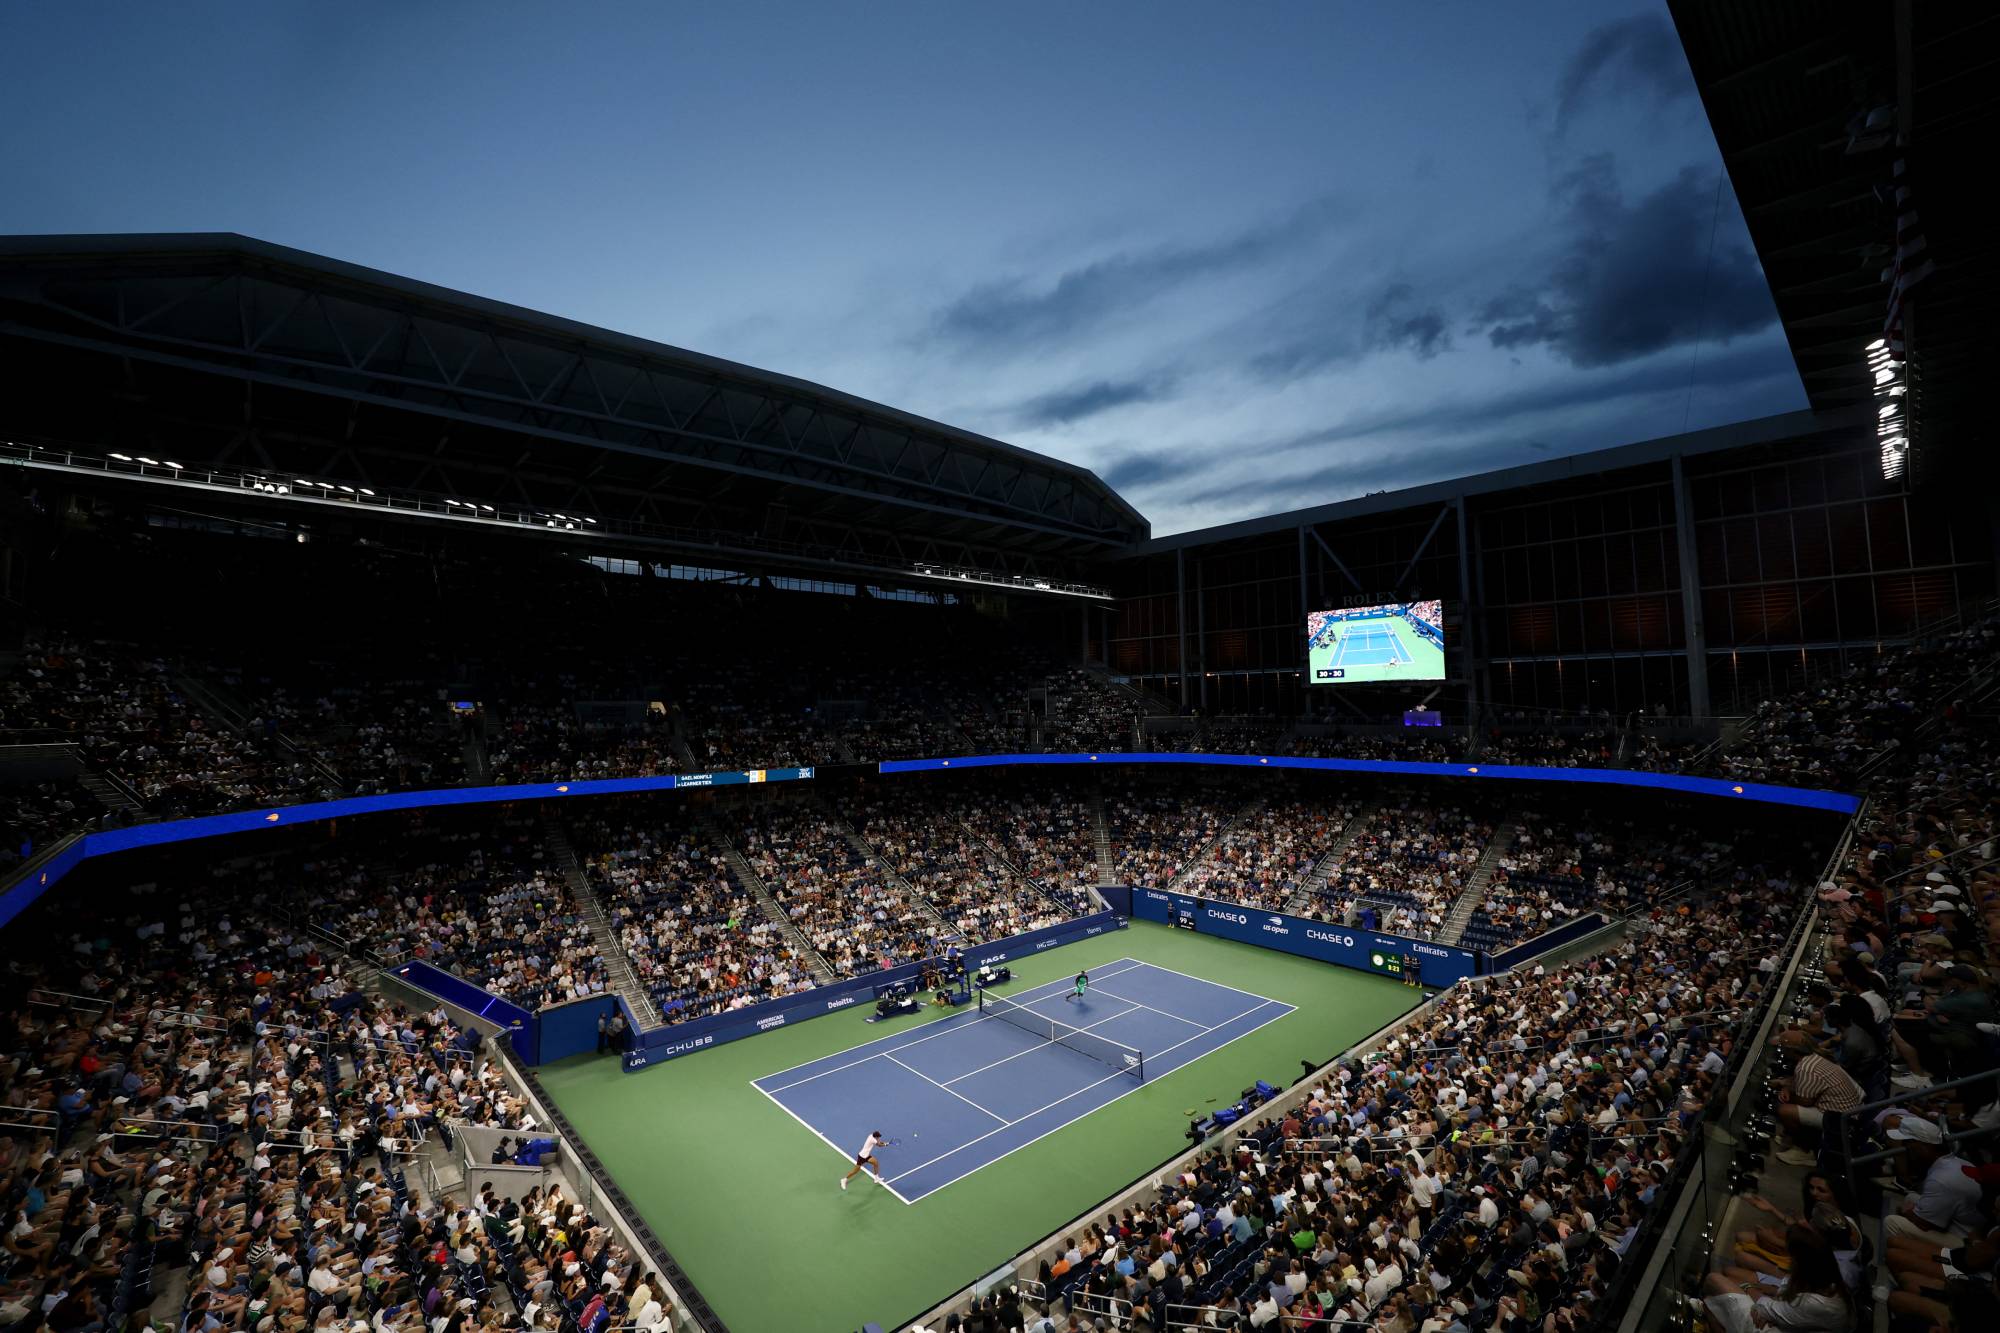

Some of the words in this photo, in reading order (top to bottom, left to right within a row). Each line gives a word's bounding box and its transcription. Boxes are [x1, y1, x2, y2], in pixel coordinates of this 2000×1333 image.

[1343, 591, 1399, 607] ROLEX
[1147, 891, 1169, 900] Emirates
[1208, 909, 1238, 922] CHASE
[1271, 926, 1289, 935] open
[1306, 929, 1343, 944] CHASE
[1412, 943, 1449, 958] Emirates
[981, 953, 1006, 965] FAGE
[828, 996, 855, 1009] Deloitte.
[757, 1014, 784, 1027] AMERICAN
[760, 1019, 785, 1030] EXPRESS
[666, 1035, 713, 1055] CHUBB
